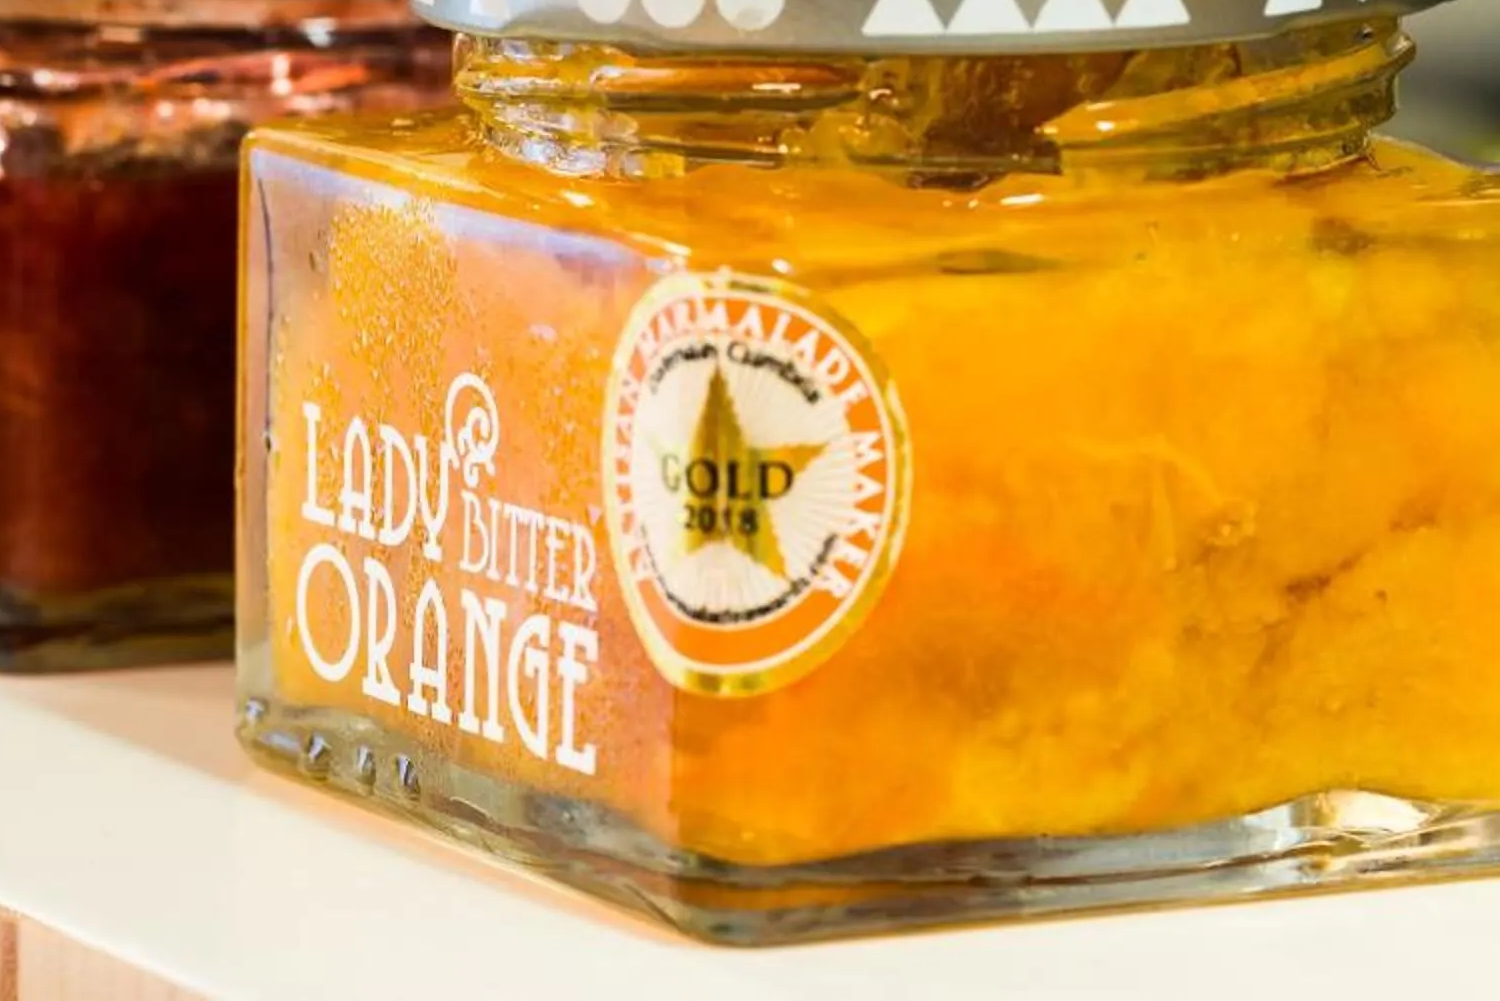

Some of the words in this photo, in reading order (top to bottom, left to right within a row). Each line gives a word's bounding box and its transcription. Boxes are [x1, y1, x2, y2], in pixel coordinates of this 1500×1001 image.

[302, 373, 499, 562] LADY
[637, 296, 871, 405] MARMALADE
[815, 431, 885, 599] MAKER
[662, 451, 795, 501] GOLD
[684, 502, 759, 537] 2018
[460, 490, 598, 612] BITTER
[297, 543, 600, 776] ORANGE
